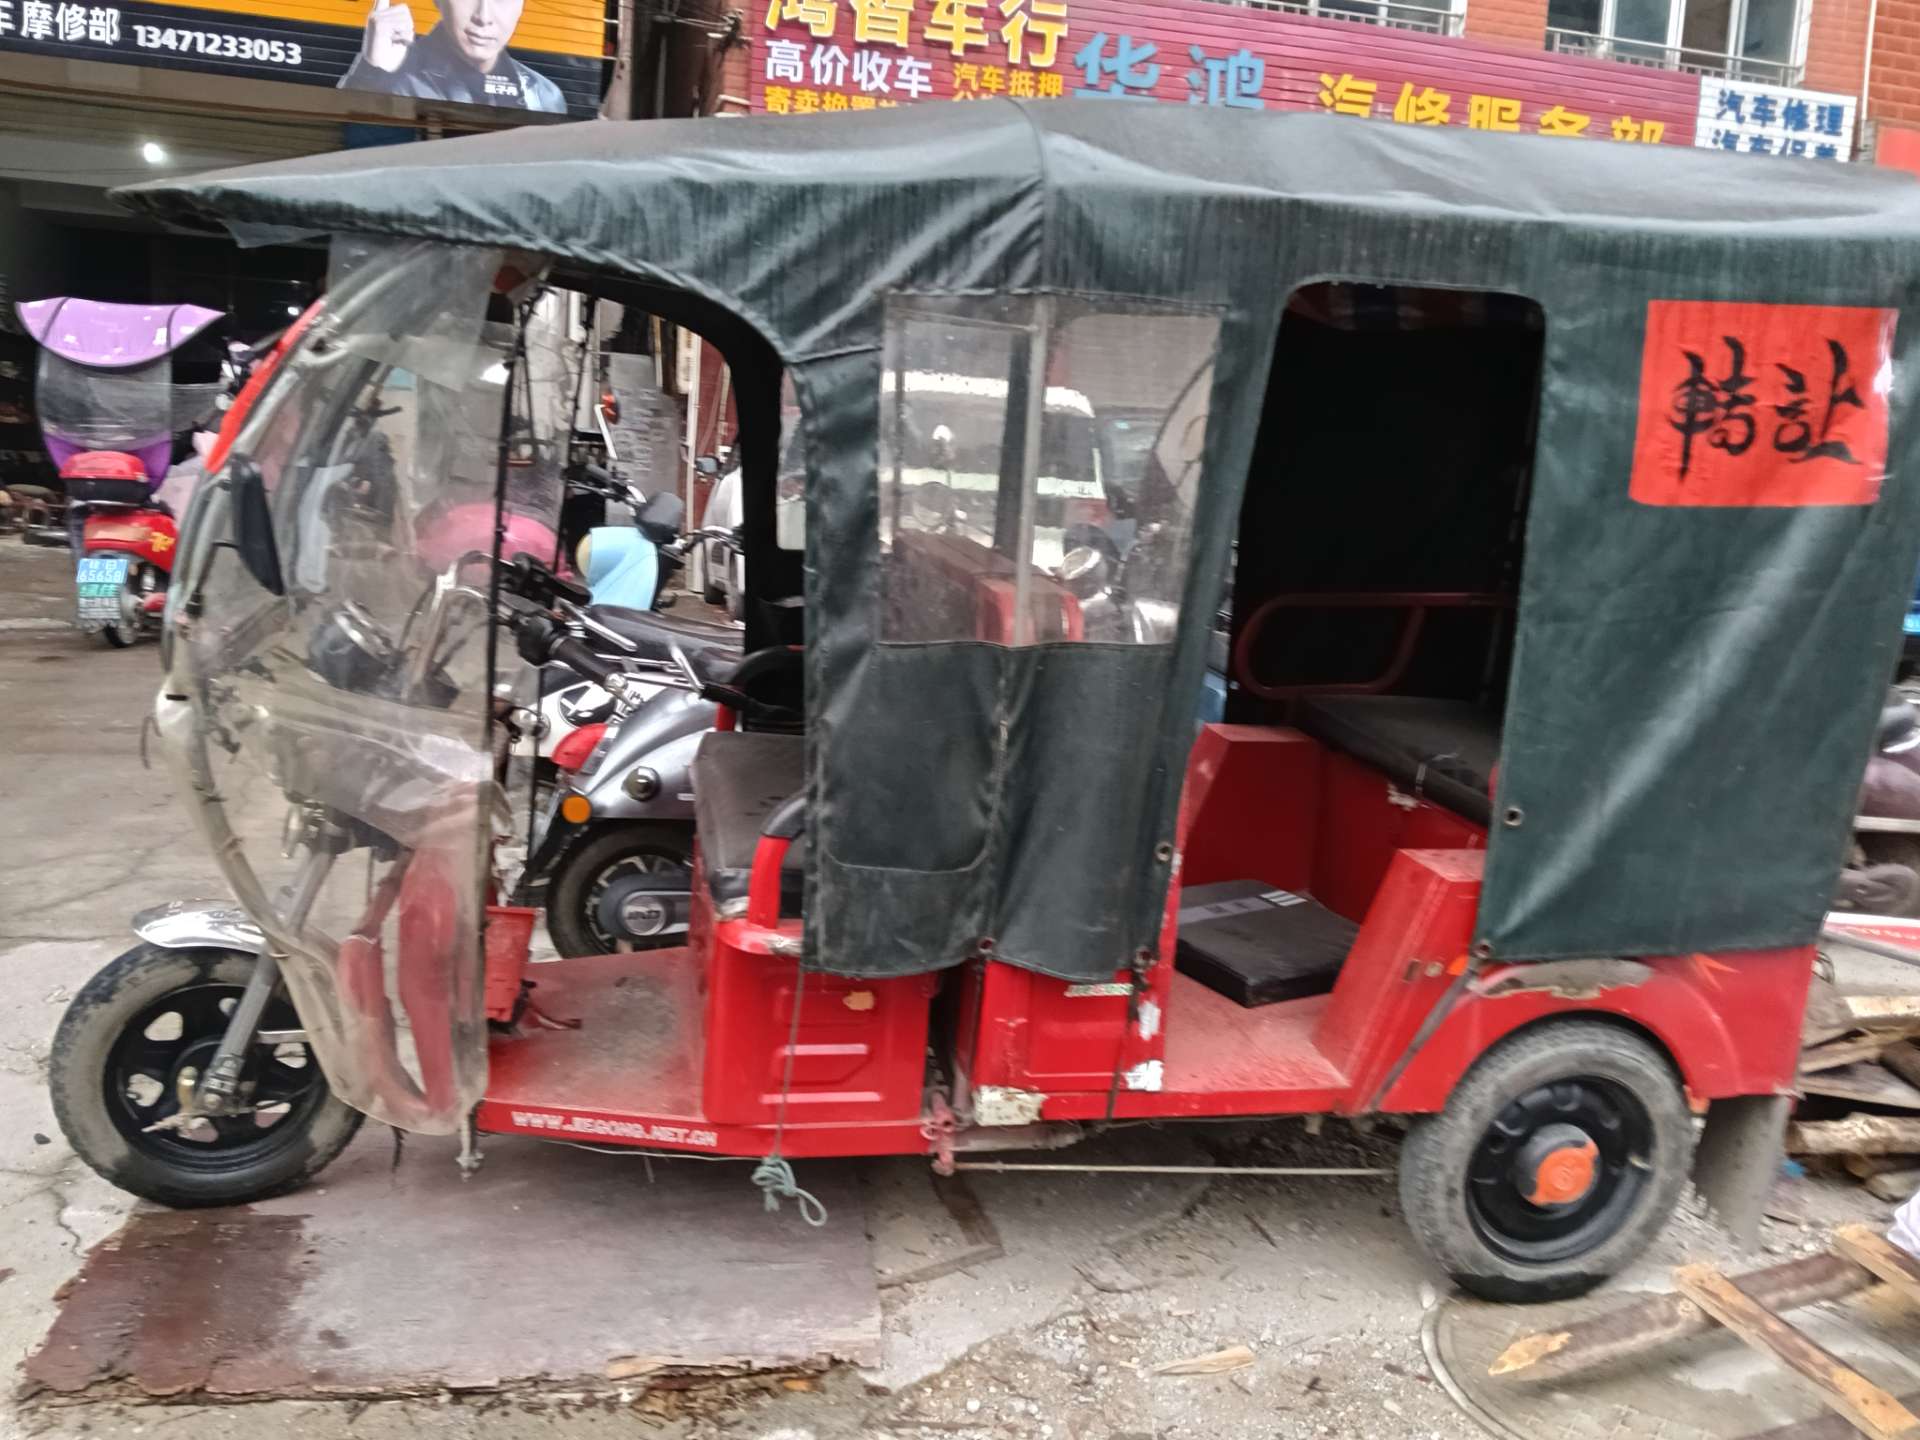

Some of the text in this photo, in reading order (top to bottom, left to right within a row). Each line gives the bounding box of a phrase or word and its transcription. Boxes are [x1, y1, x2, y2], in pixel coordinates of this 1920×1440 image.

[133, 25, 302, 64] 13471233053
[765, 39, 933, 98] 高价收车
[953, 63, 1064, 99] 汽车抵押
[1716, 89, 1844, 136] 汽车修理
